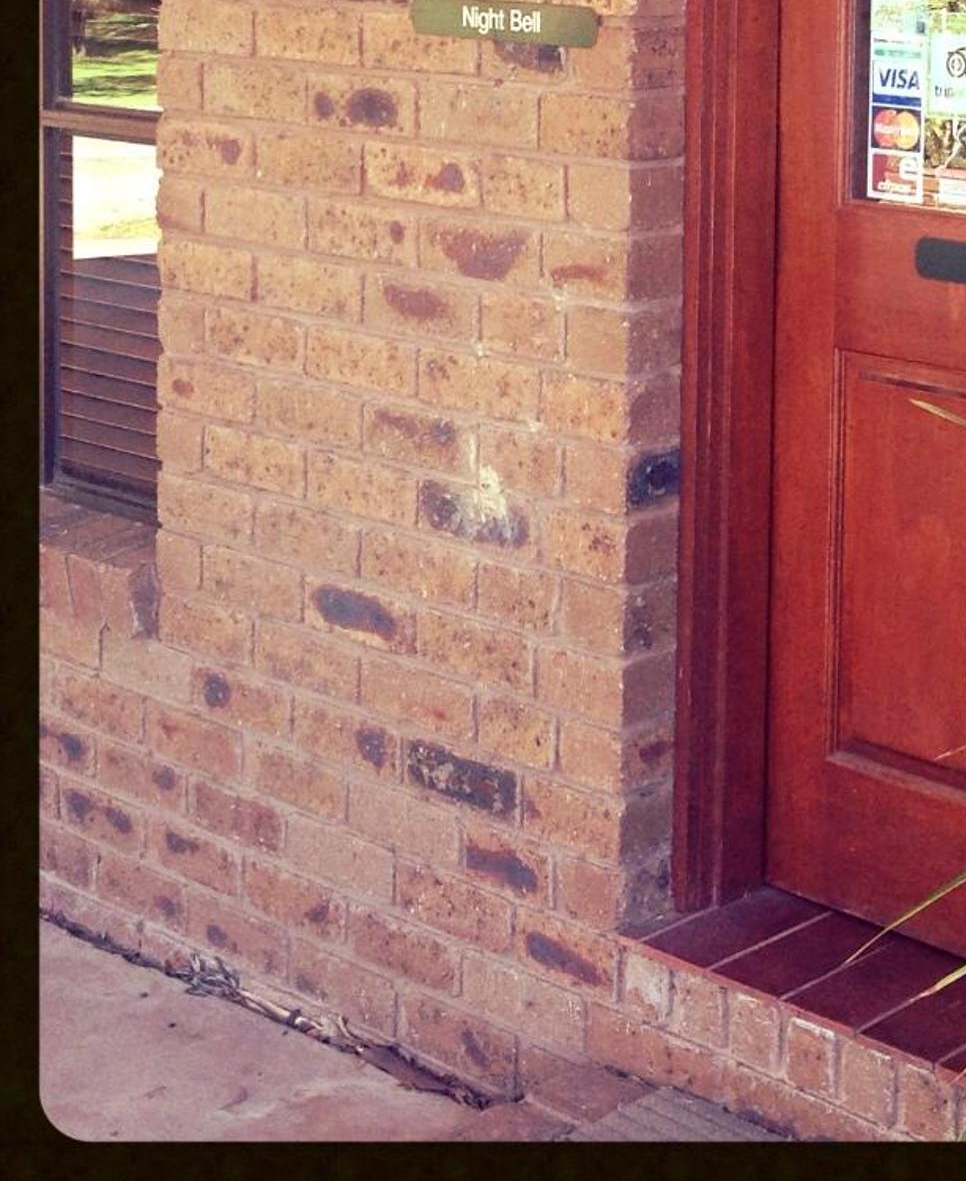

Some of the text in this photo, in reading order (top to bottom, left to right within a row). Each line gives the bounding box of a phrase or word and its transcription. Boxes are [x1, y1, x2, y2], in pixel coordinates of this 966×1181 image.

[461, 5, 541, 35] Night Bell
[878, 67, 921, 90] VISA
